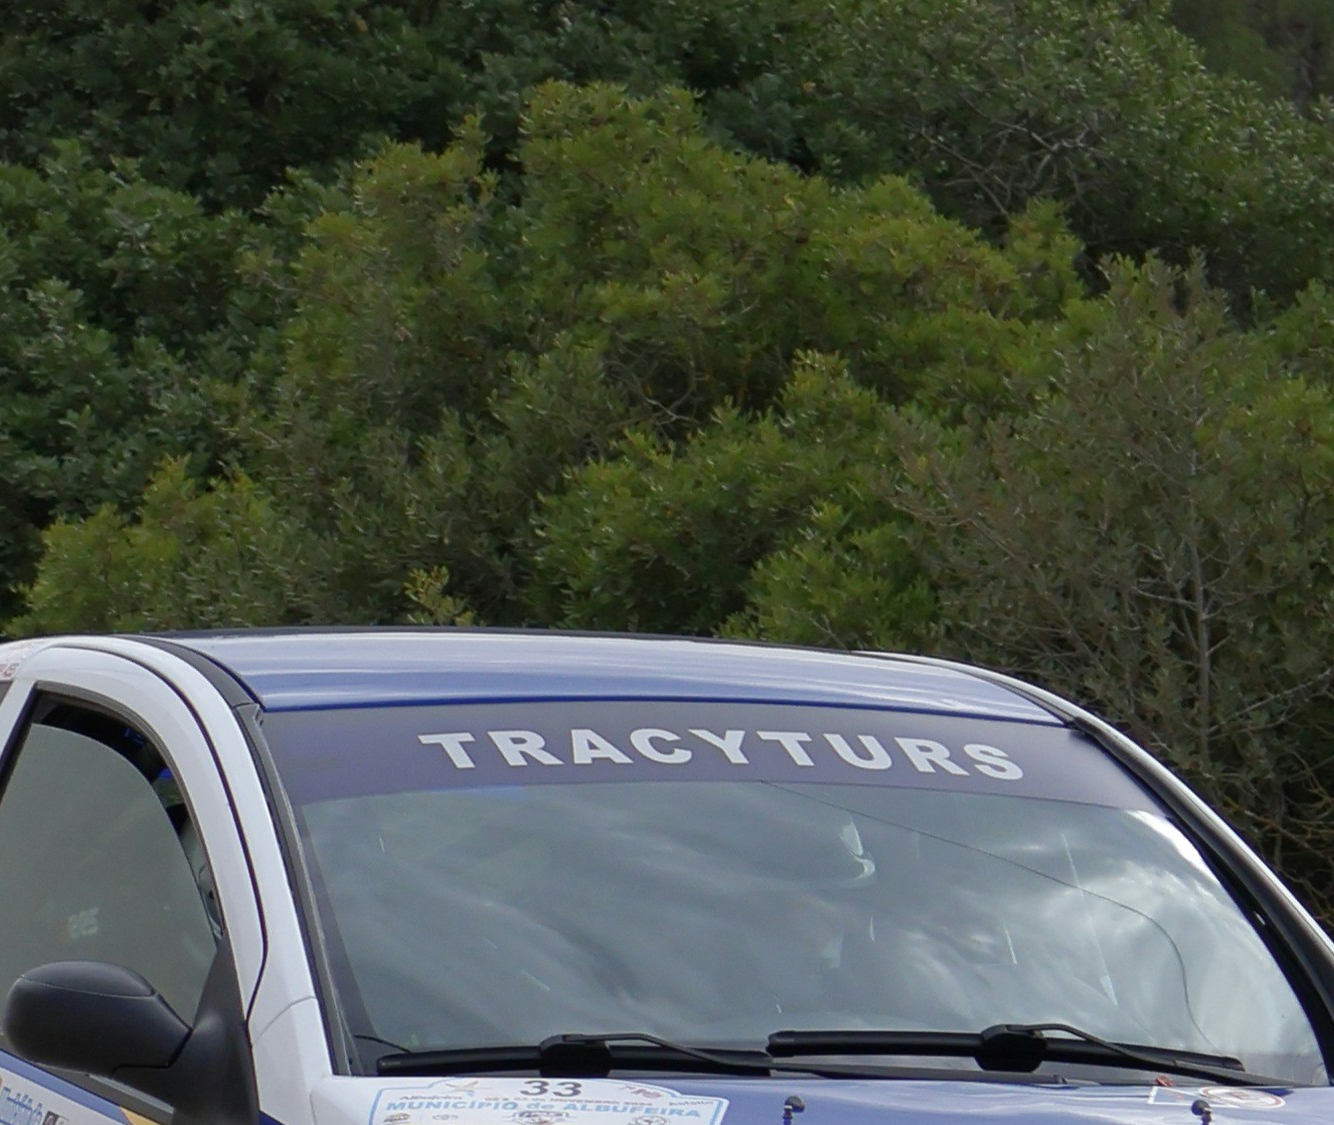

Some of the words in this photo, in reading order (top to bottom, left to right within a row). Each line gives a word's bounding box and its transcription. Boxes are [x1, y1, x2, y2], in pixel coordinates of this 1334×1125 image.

[418, 728, 1024, 781] TRACYTURS
[519, 1080, 583, 1098] 33
[525, 1101, 555, 1110] de
[563, 1103, 702, 1118] ALBUFEIRA
